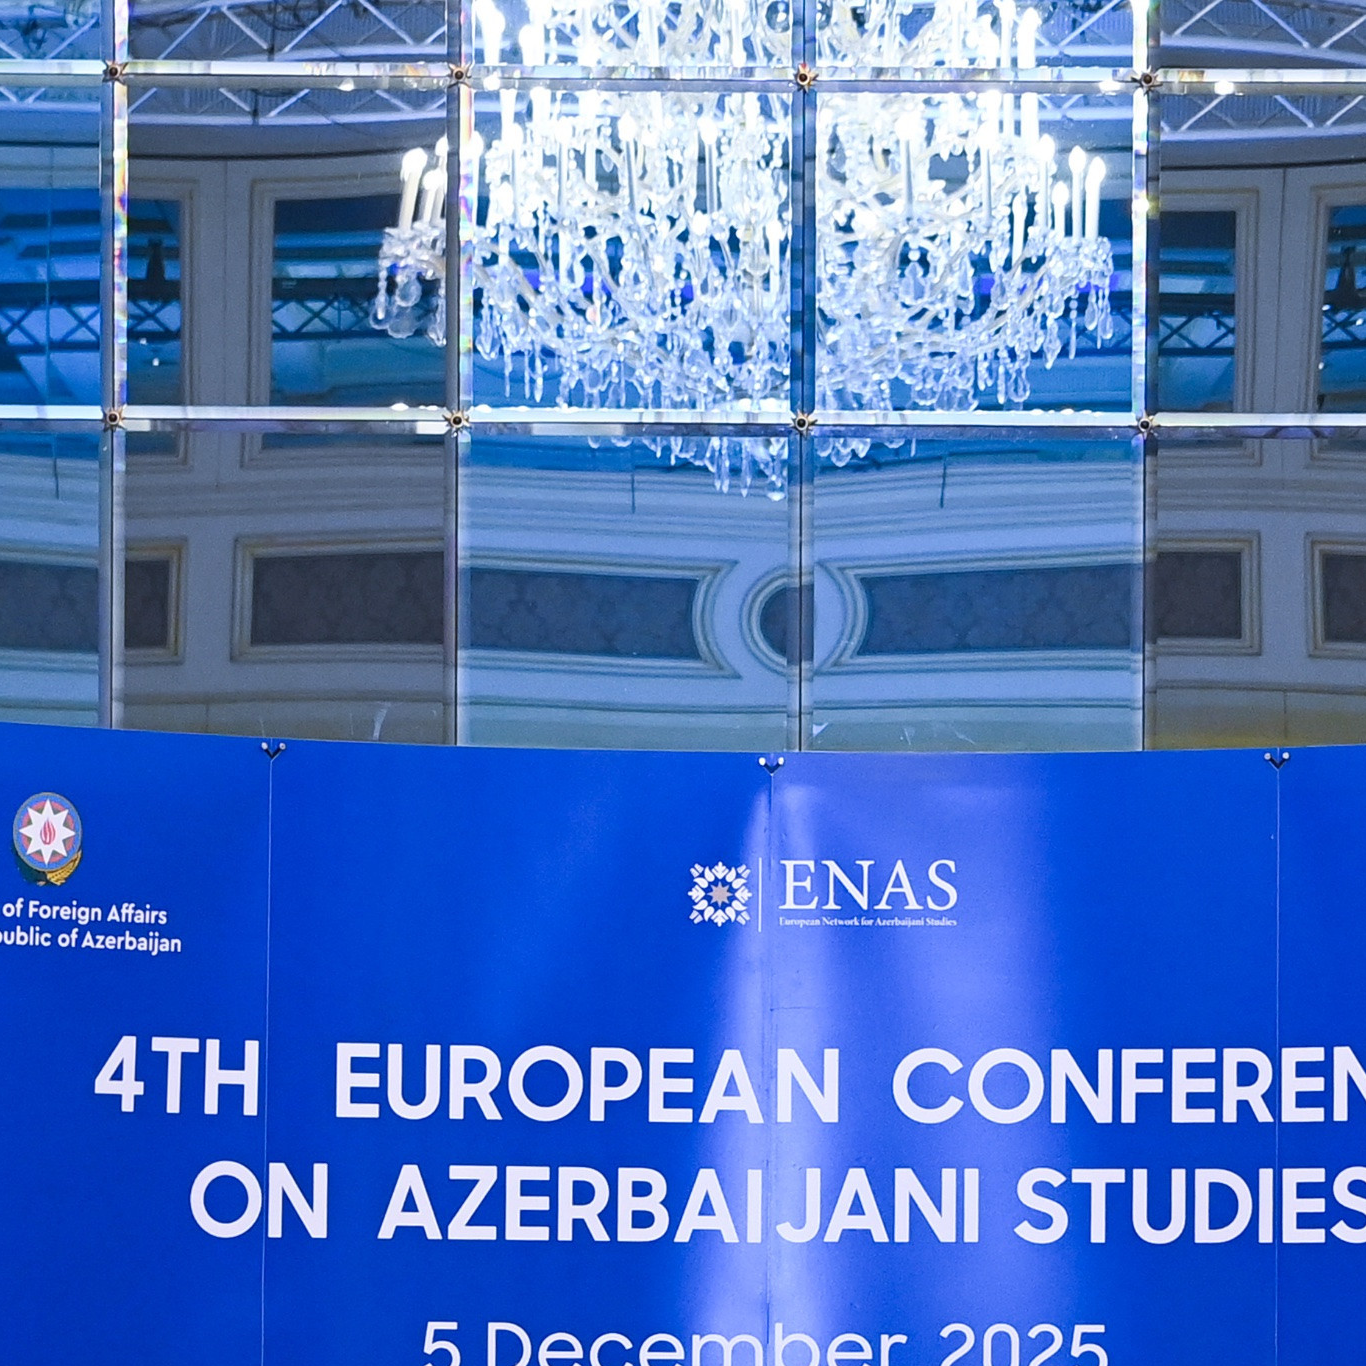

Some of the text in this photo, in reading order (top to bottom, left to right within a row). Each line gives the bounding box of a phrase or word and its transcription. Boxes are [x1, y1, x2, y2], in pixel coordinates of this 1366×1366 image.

[778, 859, 958, 911] ENAS
[2, 898, 24, 918] of
[28, 900, 102, 925] Foreign
[107, 903, 168, 925] Affairs
[779, 916, 957, 928] European Network for Azerbaijani Studies
[57, 928, 79, 948] of
[81, 930, 182, 956] Azerbaijan
[94, 1036, 259, 1115] 4TH
[336, 1043, 839, 1124] EUROPEAN
[190, 1161, 328, 1238] ON
[378, 1165, 979, 1244] AZERBAIJANI
